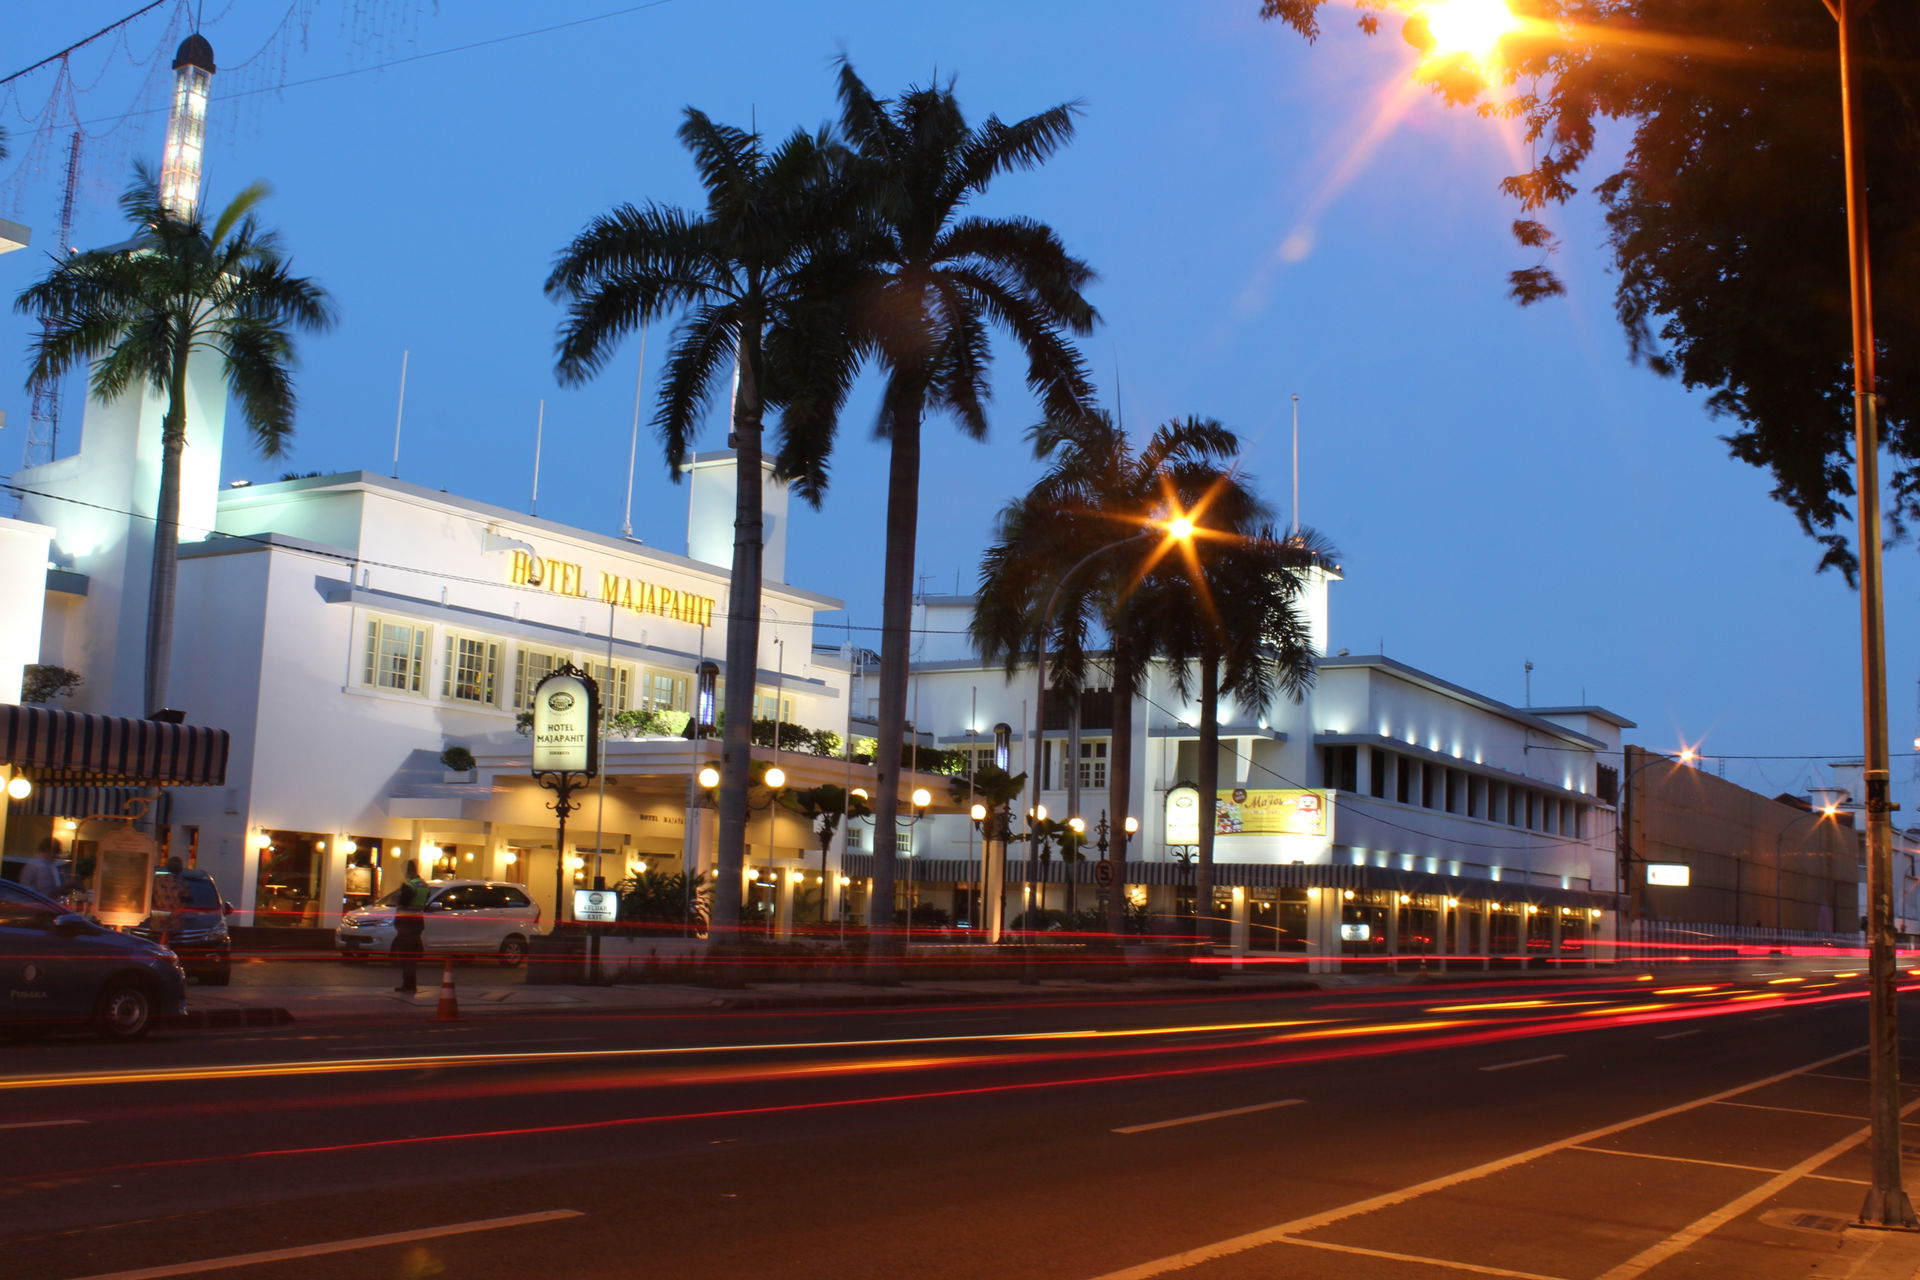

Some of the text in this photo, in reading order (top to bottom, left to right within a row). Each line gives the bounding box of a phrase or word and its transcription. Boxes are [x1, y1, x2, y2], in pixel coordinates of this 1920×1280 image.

[511, 549, 715, 628] HOTEL MAJAPAHIT
[547, 724, 574, 732] HOTEL
[537, 735, 585, 744] MAJAPAHIT
